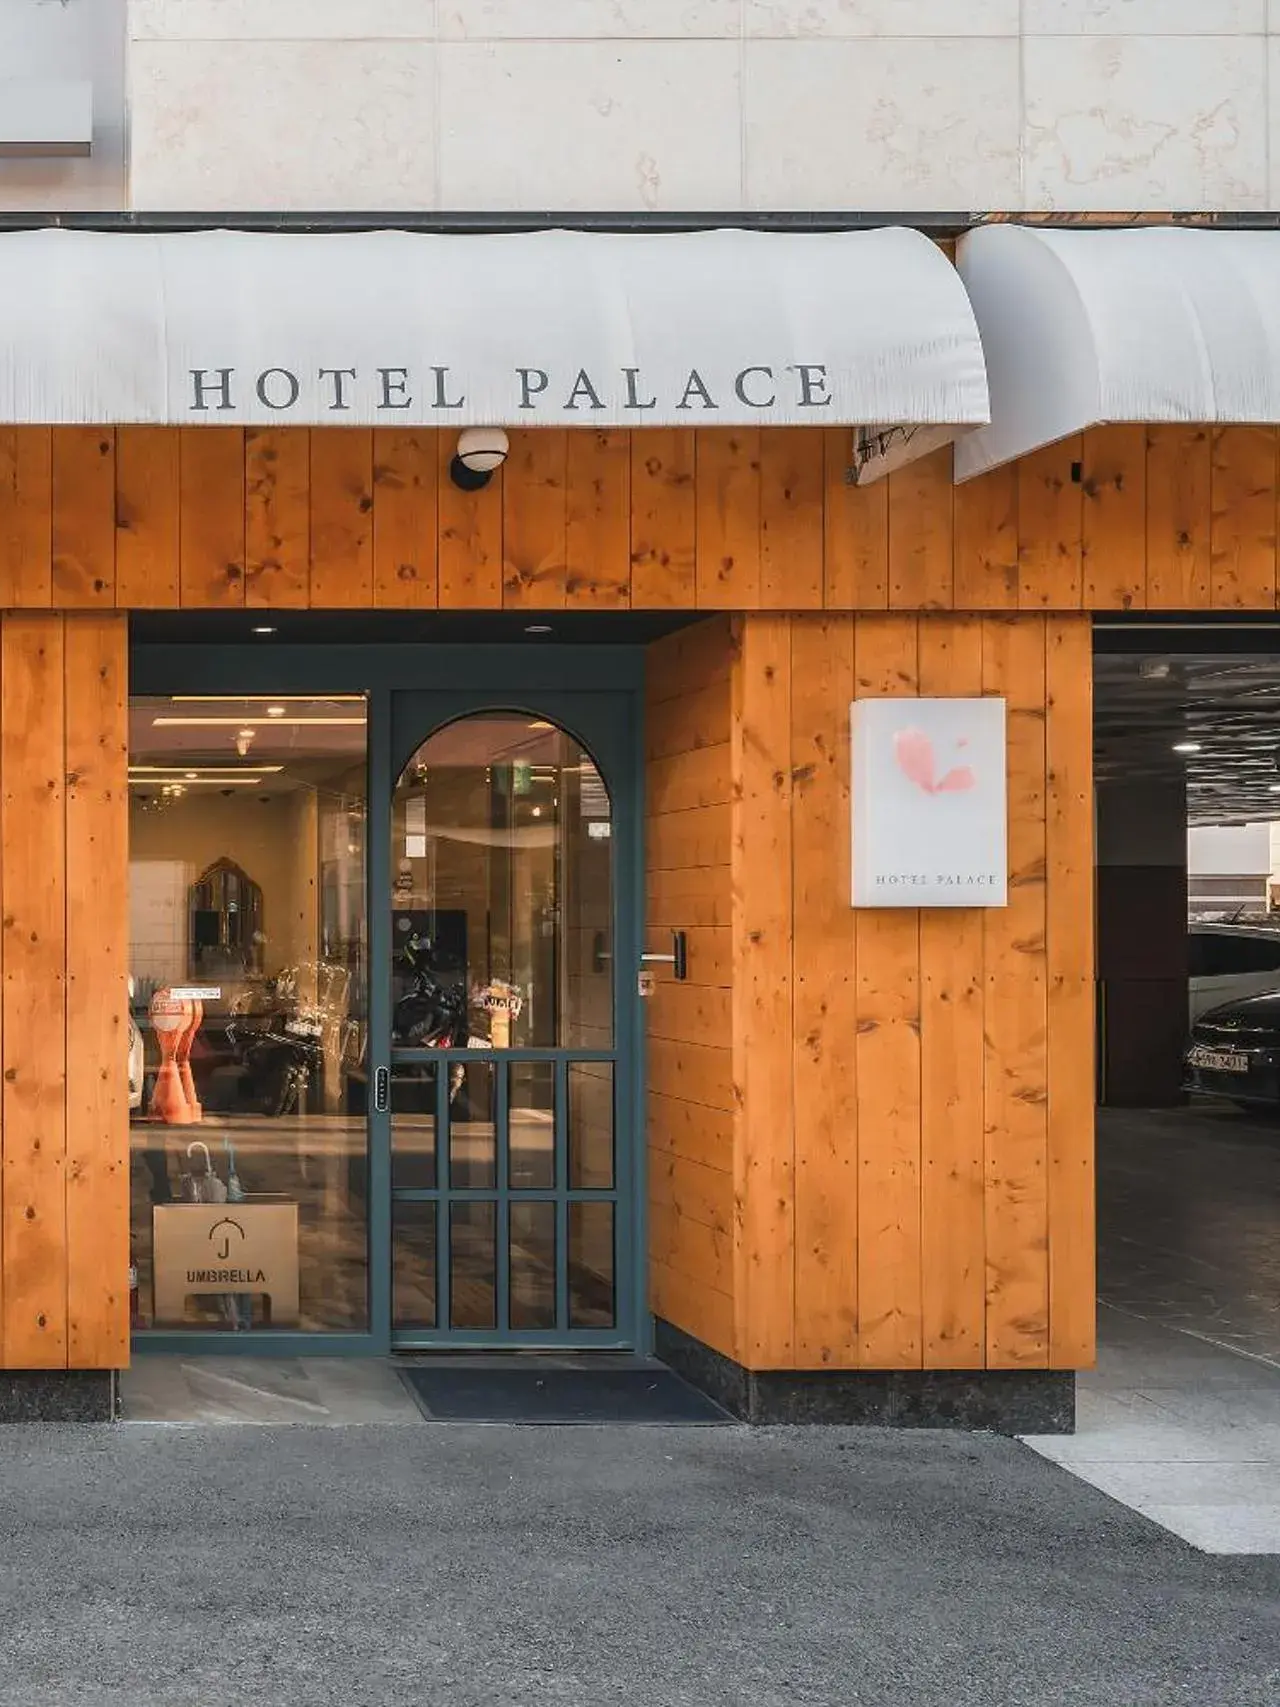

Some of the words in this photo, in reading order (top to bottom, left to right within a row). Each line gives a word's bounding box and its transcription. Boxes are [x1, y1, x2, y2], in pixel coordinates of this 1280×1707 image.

[189, 366, 465, 410] HOTEL
[515, 364, 833, 410] PALACE
[876, 874, 926, 885] HOTEL
[937, 874, 998, 885] PALACE
[186, 1269, 266, 1283] UMBRELLA
